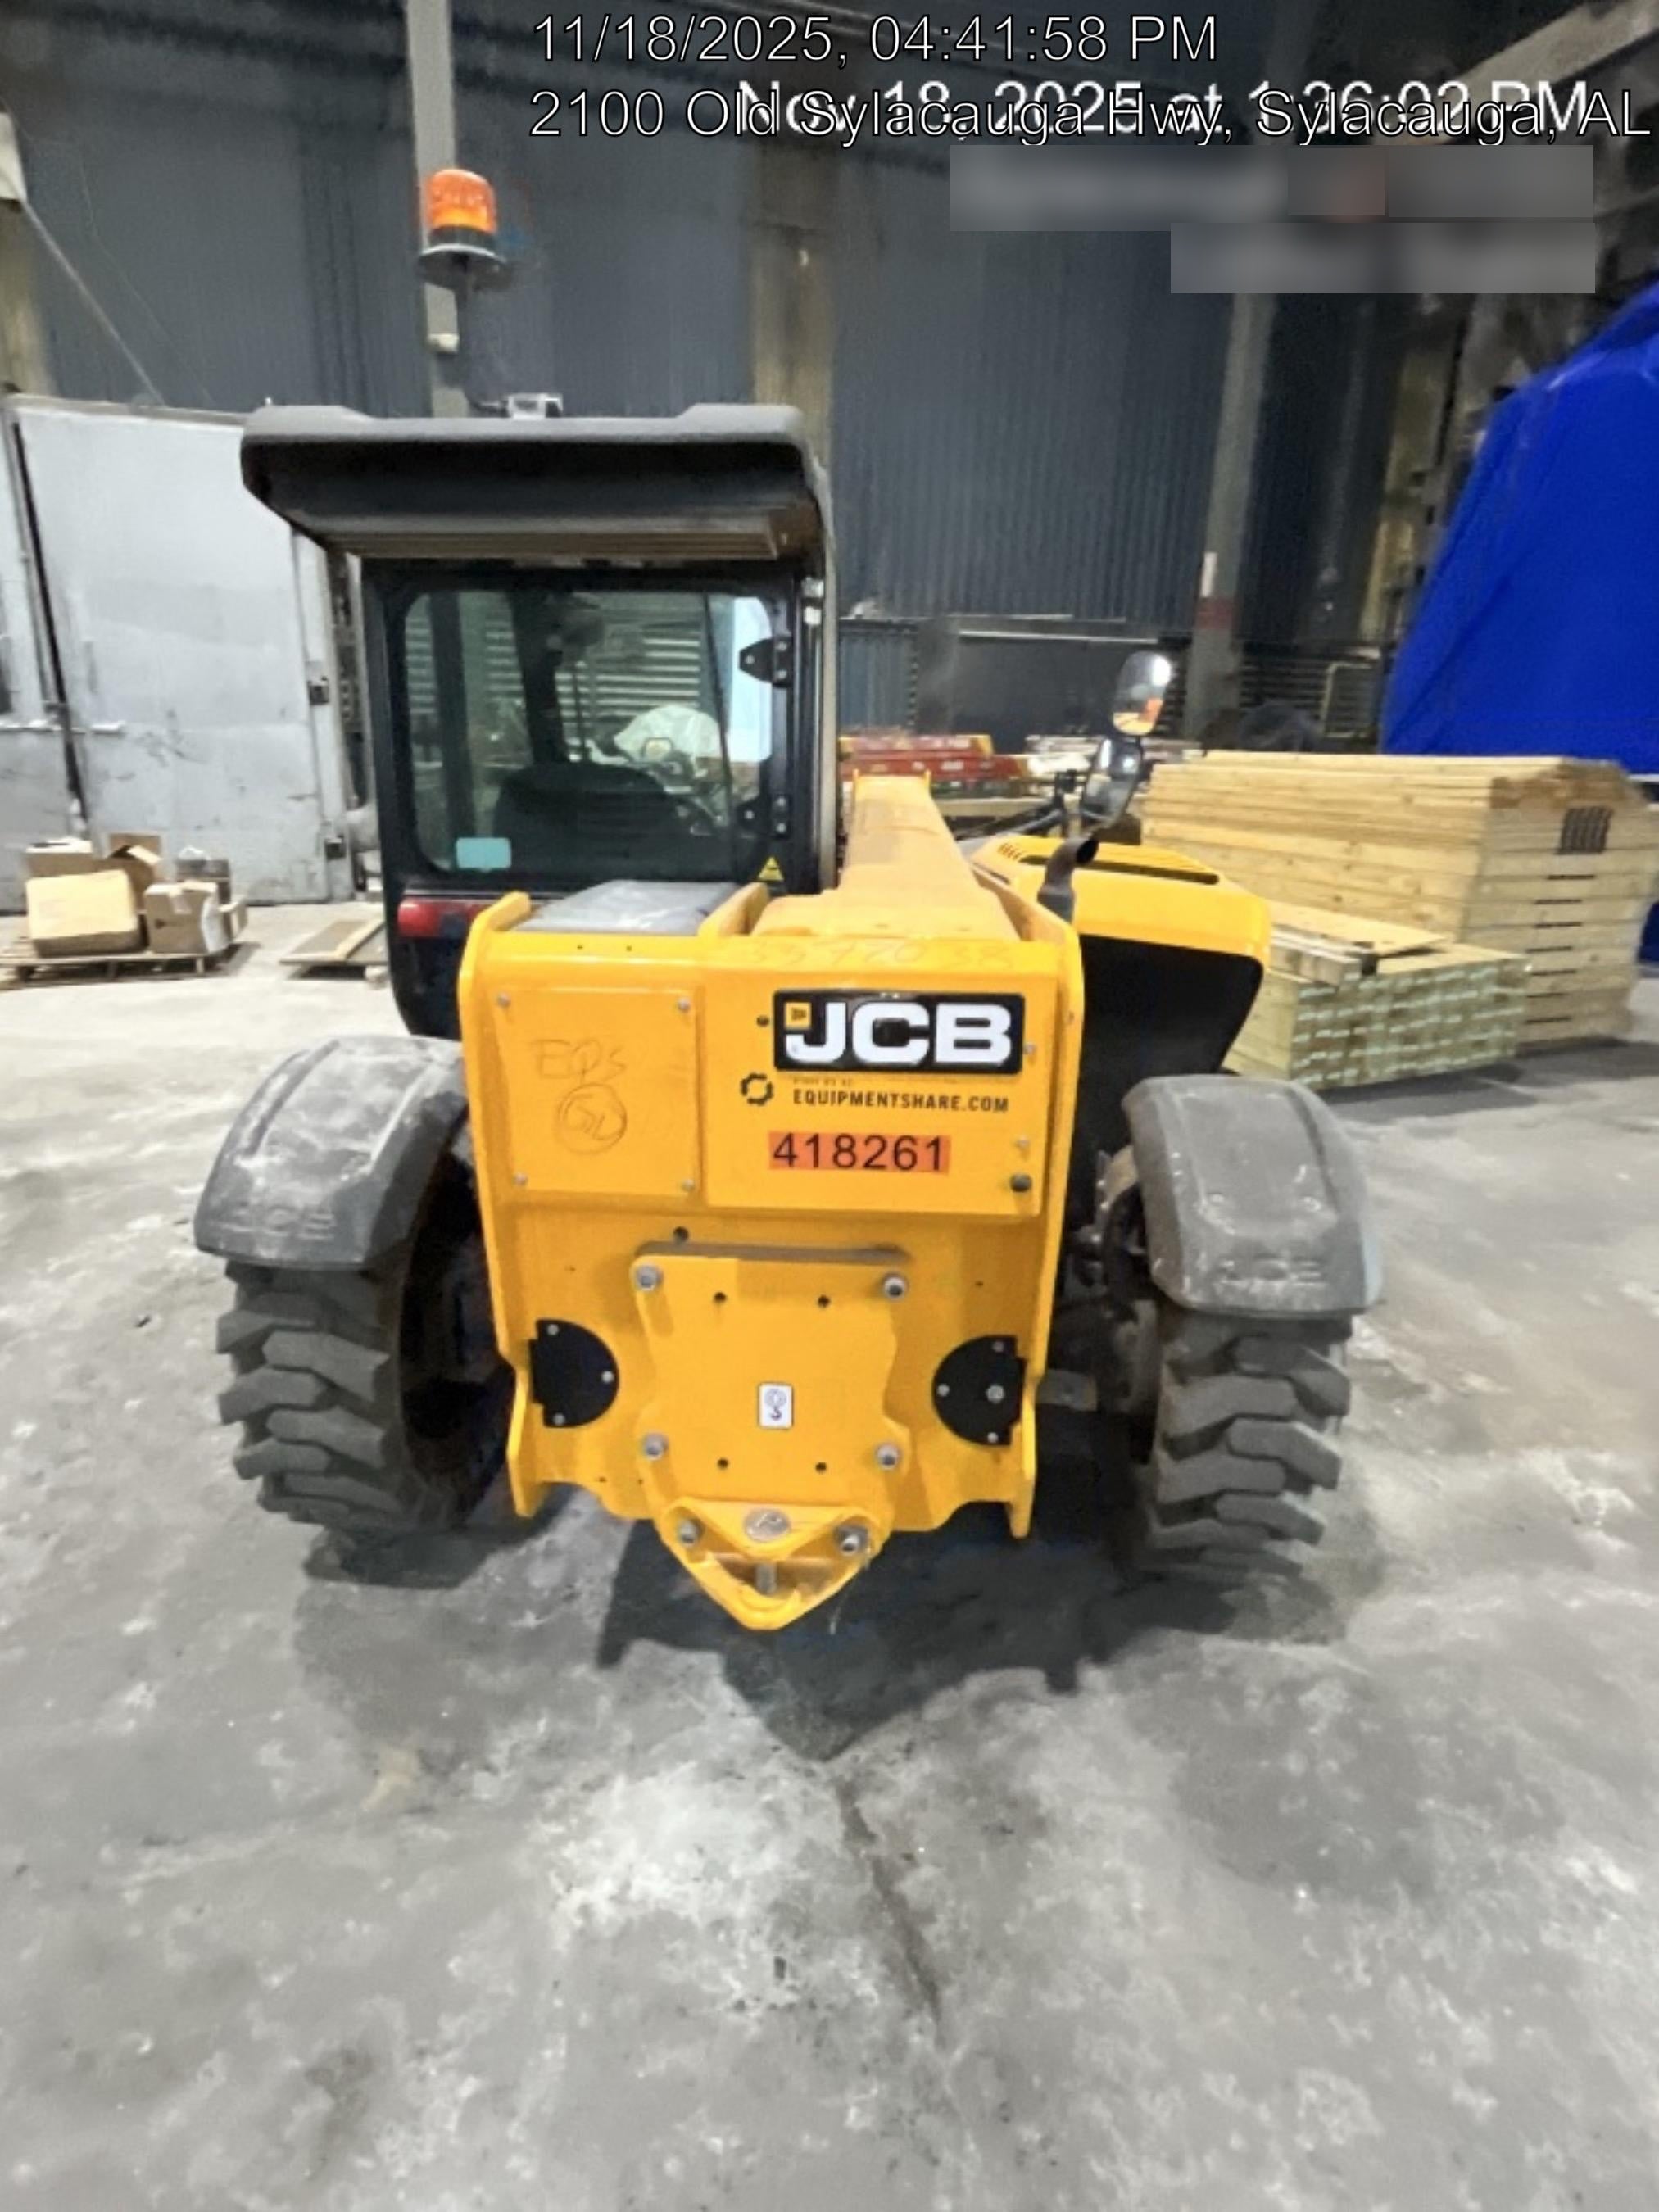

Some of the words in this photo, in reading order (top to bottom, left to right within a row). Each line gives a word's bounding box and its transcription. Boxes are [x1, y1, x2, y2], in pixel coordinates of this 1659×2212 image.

[784, 1001, 1013, 1063] JCB
[792, 1089, 1010, 1113] EQUIPMENTSHARE.COM
[773, 1131, 944, 1172] 418261
